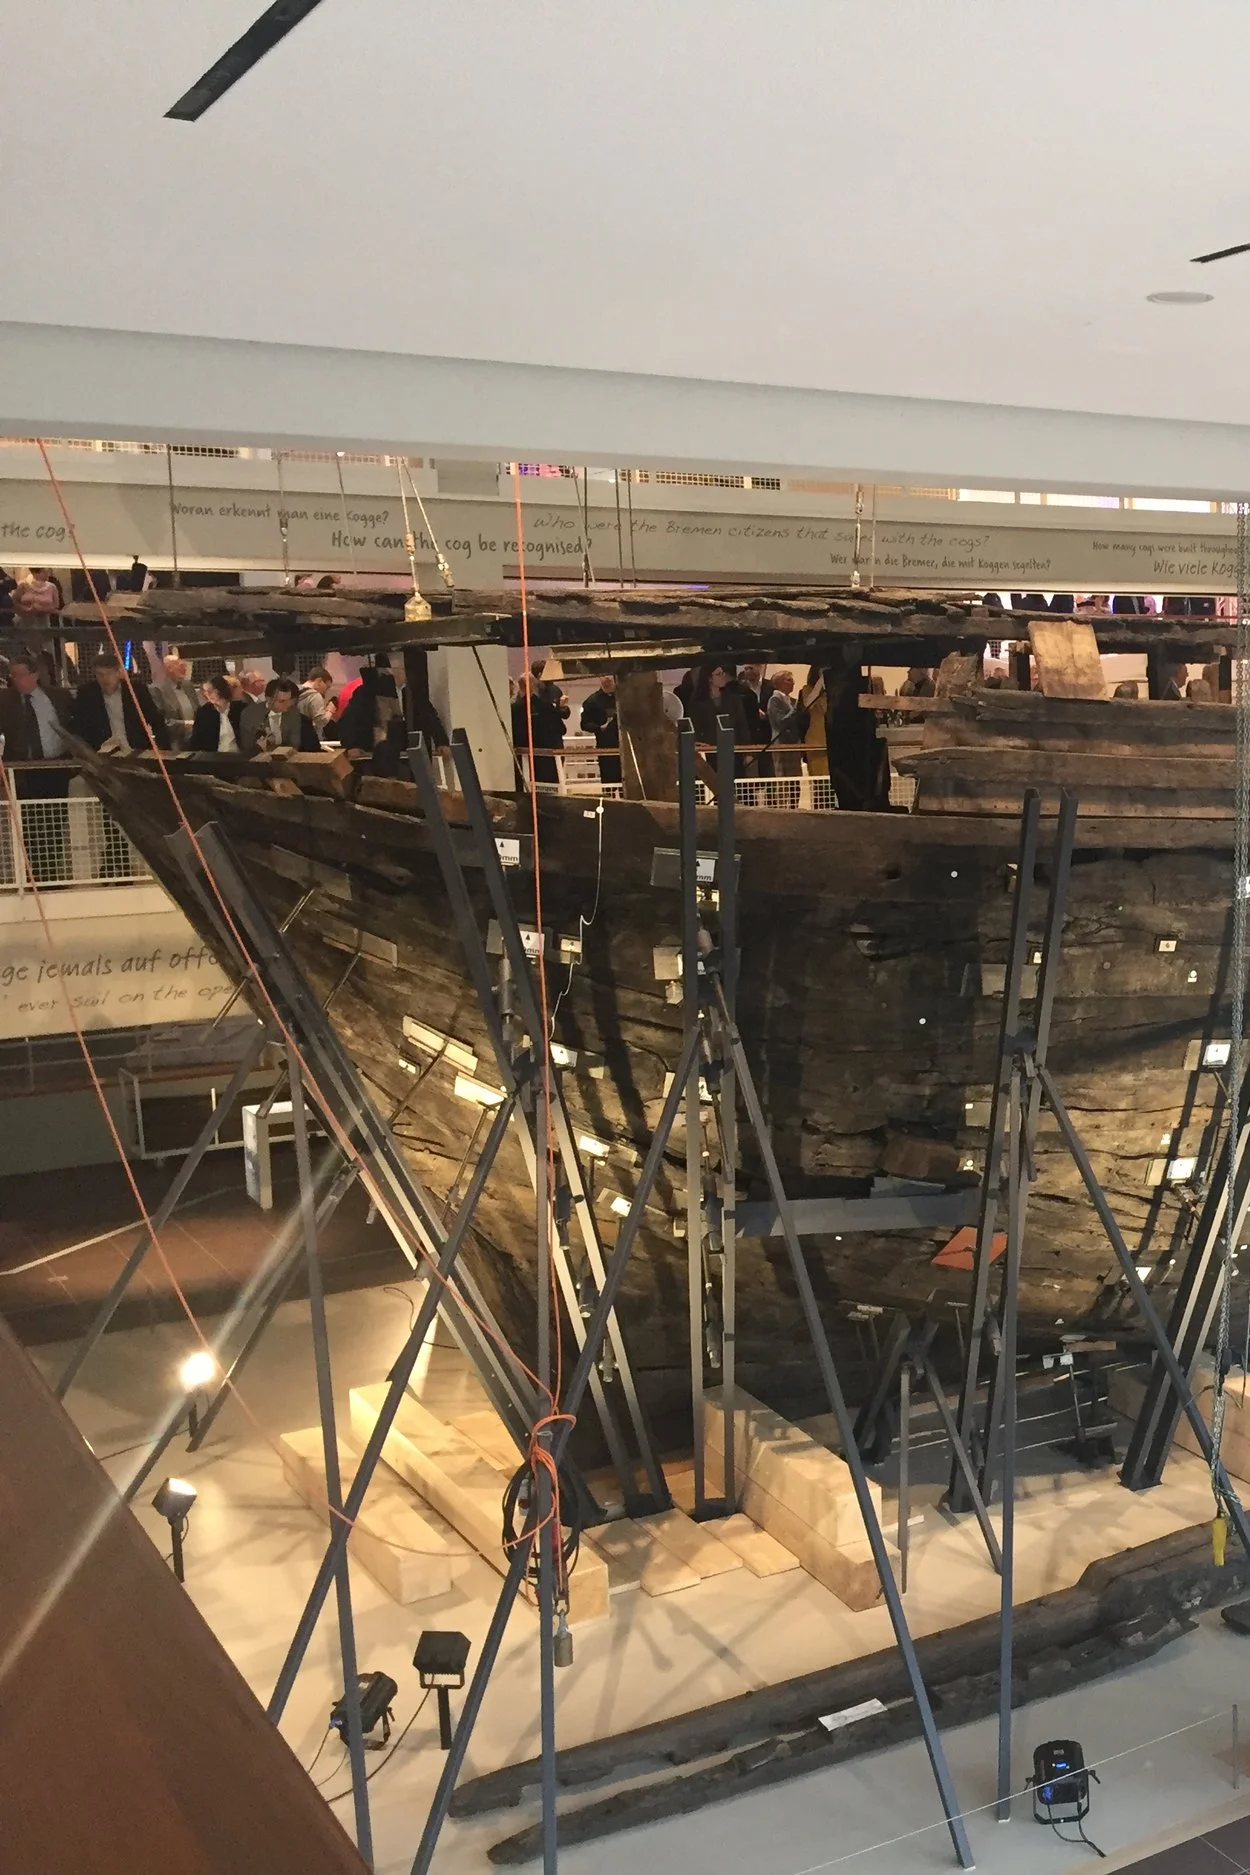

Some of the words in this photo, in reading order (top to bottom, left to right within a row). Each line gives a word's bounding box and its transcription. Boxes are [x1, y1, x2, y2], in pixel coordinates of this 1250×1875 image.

[171, 502, 213, 516] Woran
[219, 502, 271, 518] erkennt
[313, 510, 341, 521] eine
[1, 521, 30, 539] the
[36, 523, 75, 544] cog
[331, 530, 367, 549] How
[374, 537, 405, 550] can
[445, 538, 473, 559] cog
[478, 531, 497, 552] be
[533, 512, 577, 530] Who
[665, 519, 722, 537] Bremen
[727, 523, 790, 540] citizens
[796, 525, 829, 542] that
[881, 530, 915, 546] with
[919, 530, 943, 547] the
[948, 533, 990, 553] cogs?
[830, 552, 849, 566] Wer
[851, 555, 882, 567] warn
[884, 553, 900, 567] die
[902, 553, 939, 569] Bremer,
[941, 555, 956, 568] die
[958, 555, 975, 569] mit
[978, 556, 1010, 574] Koggen
[1153, 559, 1176, 575] Wie
[1178, 559, 1209, 576] viele
[1212, 559, 1243, 579] Kogg
[37, 952, 113, 983] jemals
[120, 946, 163, 973] auf
[17, 998, 60, 1012] ever
[118, 992, 146, 1004] on
[153, 984, 189, 1001] the
[197, 984, 236, 1002] ope
